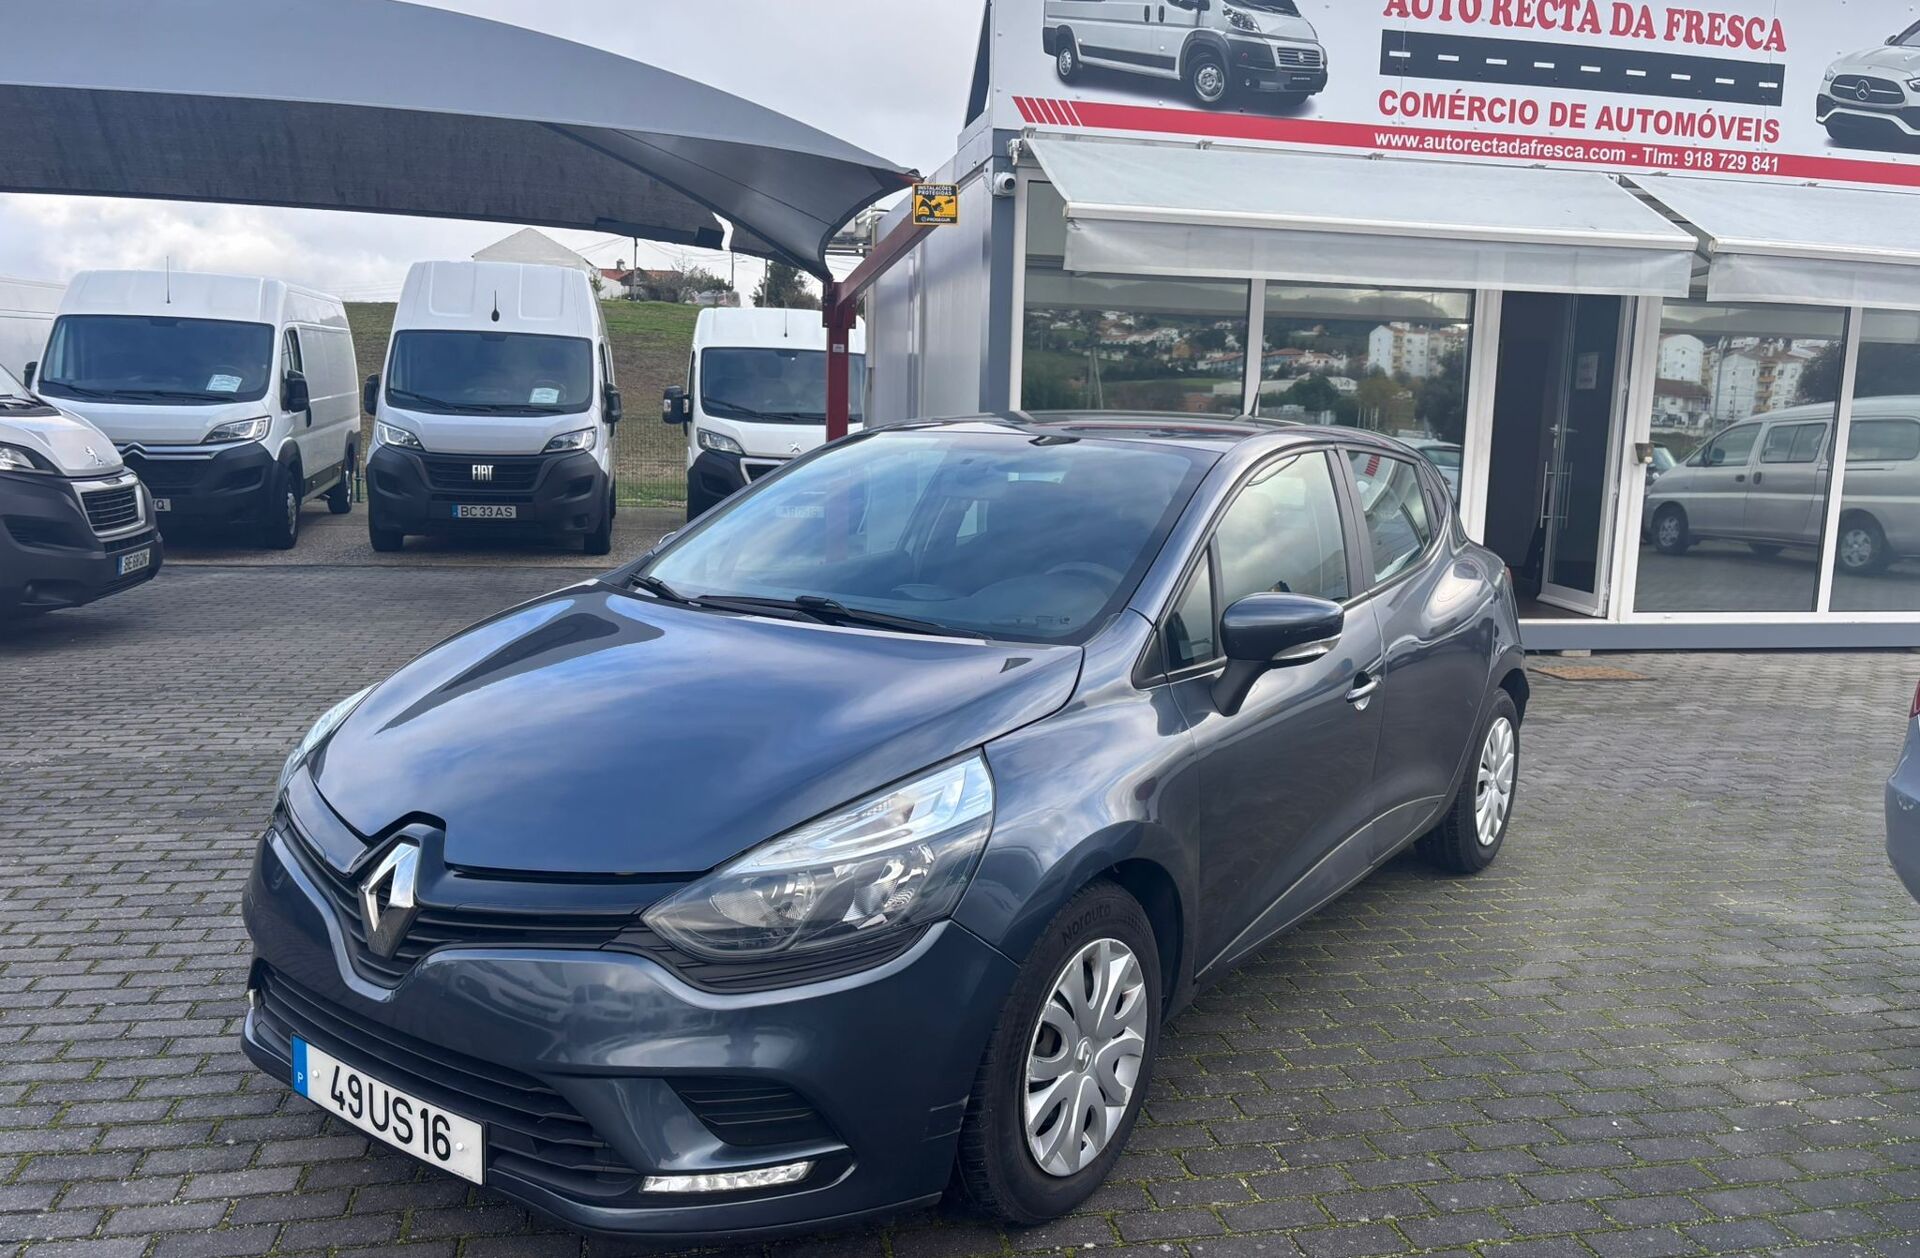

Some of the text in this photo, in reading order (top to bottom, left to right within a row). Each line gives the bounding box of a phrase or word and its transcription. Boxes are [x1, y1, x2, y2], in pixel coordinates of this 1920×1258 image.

[1489, 0, 1602, 33] RECTA
[1609, 2, 1656, 39] DA
[1663, 8, 1787, 52] FRESCA
[1378, 88, 1780, 144] COMÉRCIO DE AUTOMÓVEIS
[1374, 132, 1626, 162] www.autorectadafresca.com
[1642, 147, 1679, 166] Tlm:
[1684, 151, 1714, 168] 918
[1718, 153, 1747, 171] 729
[1751, 155, 1779, 173] 841
[472, 464, 494, 480] FIAT
[297, 1071, 304, 1084] P
